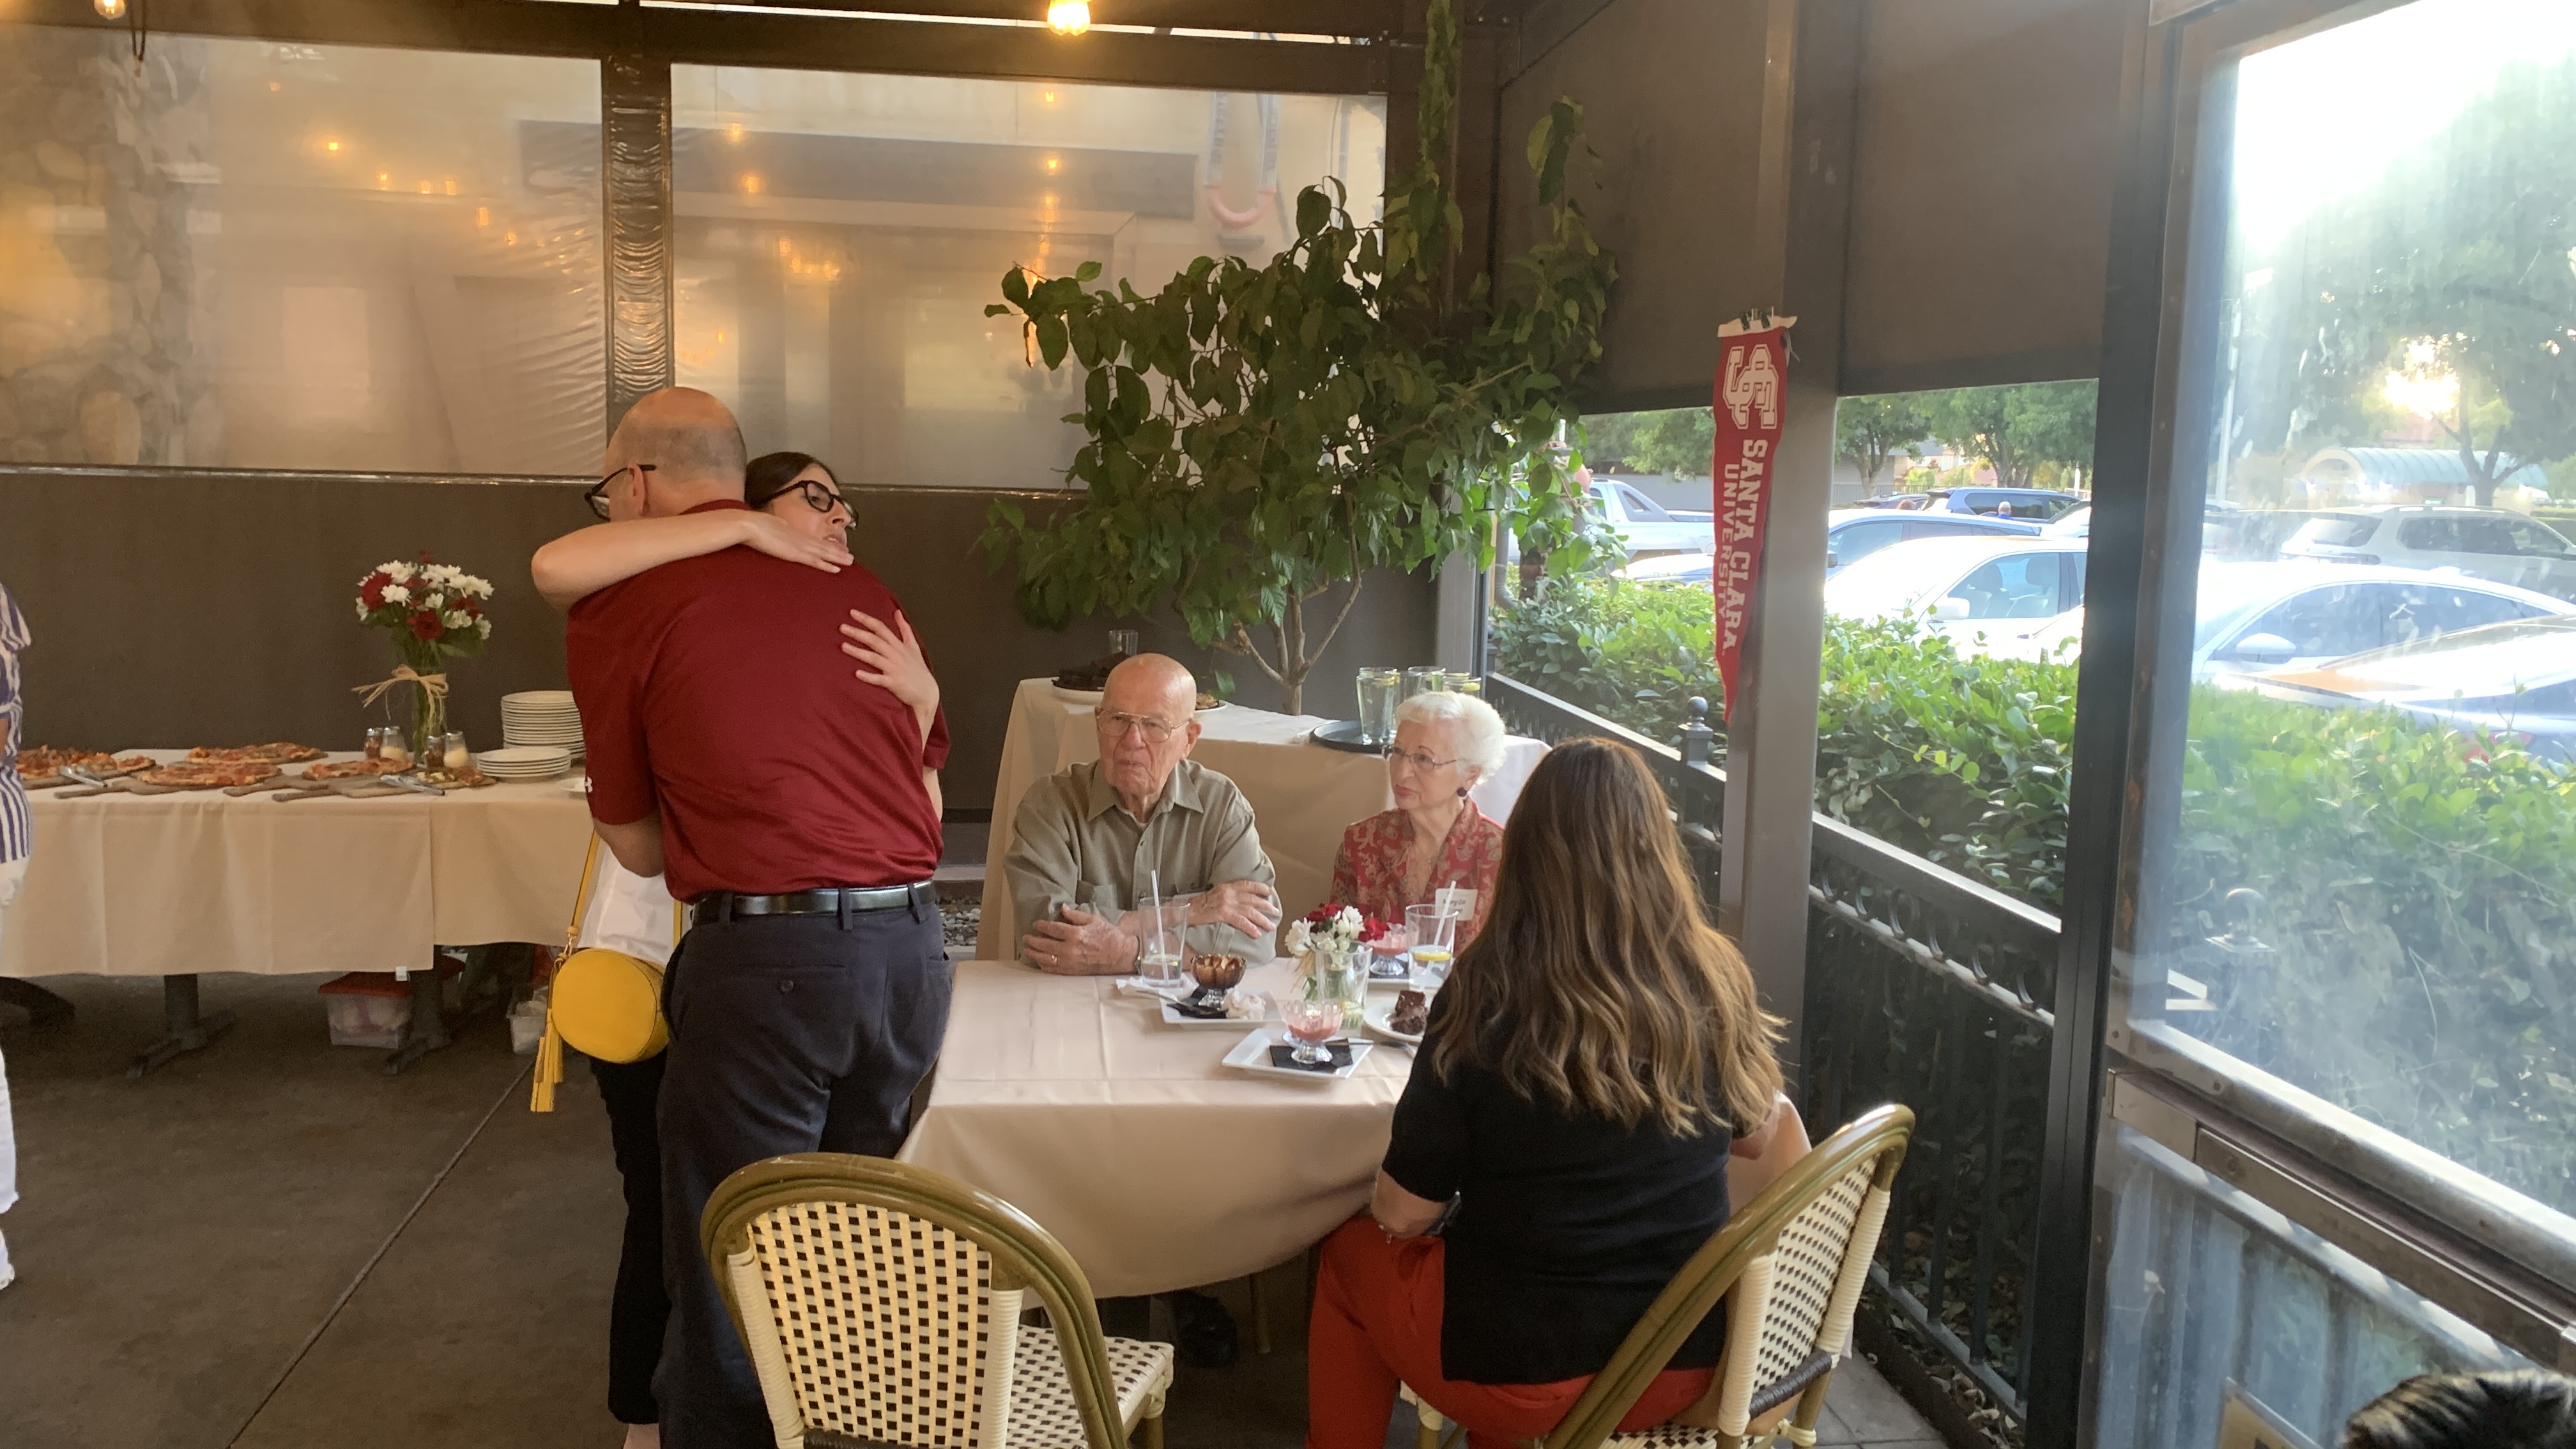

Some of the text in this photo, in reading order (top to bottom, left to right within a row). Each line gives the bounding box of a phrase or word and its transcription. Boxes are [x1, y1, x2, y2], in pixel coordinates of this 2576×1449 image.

[1718, 464, 1740, 618] UNIVERSITY
[1722, 440, 1768, 650] SANTA CLARA
